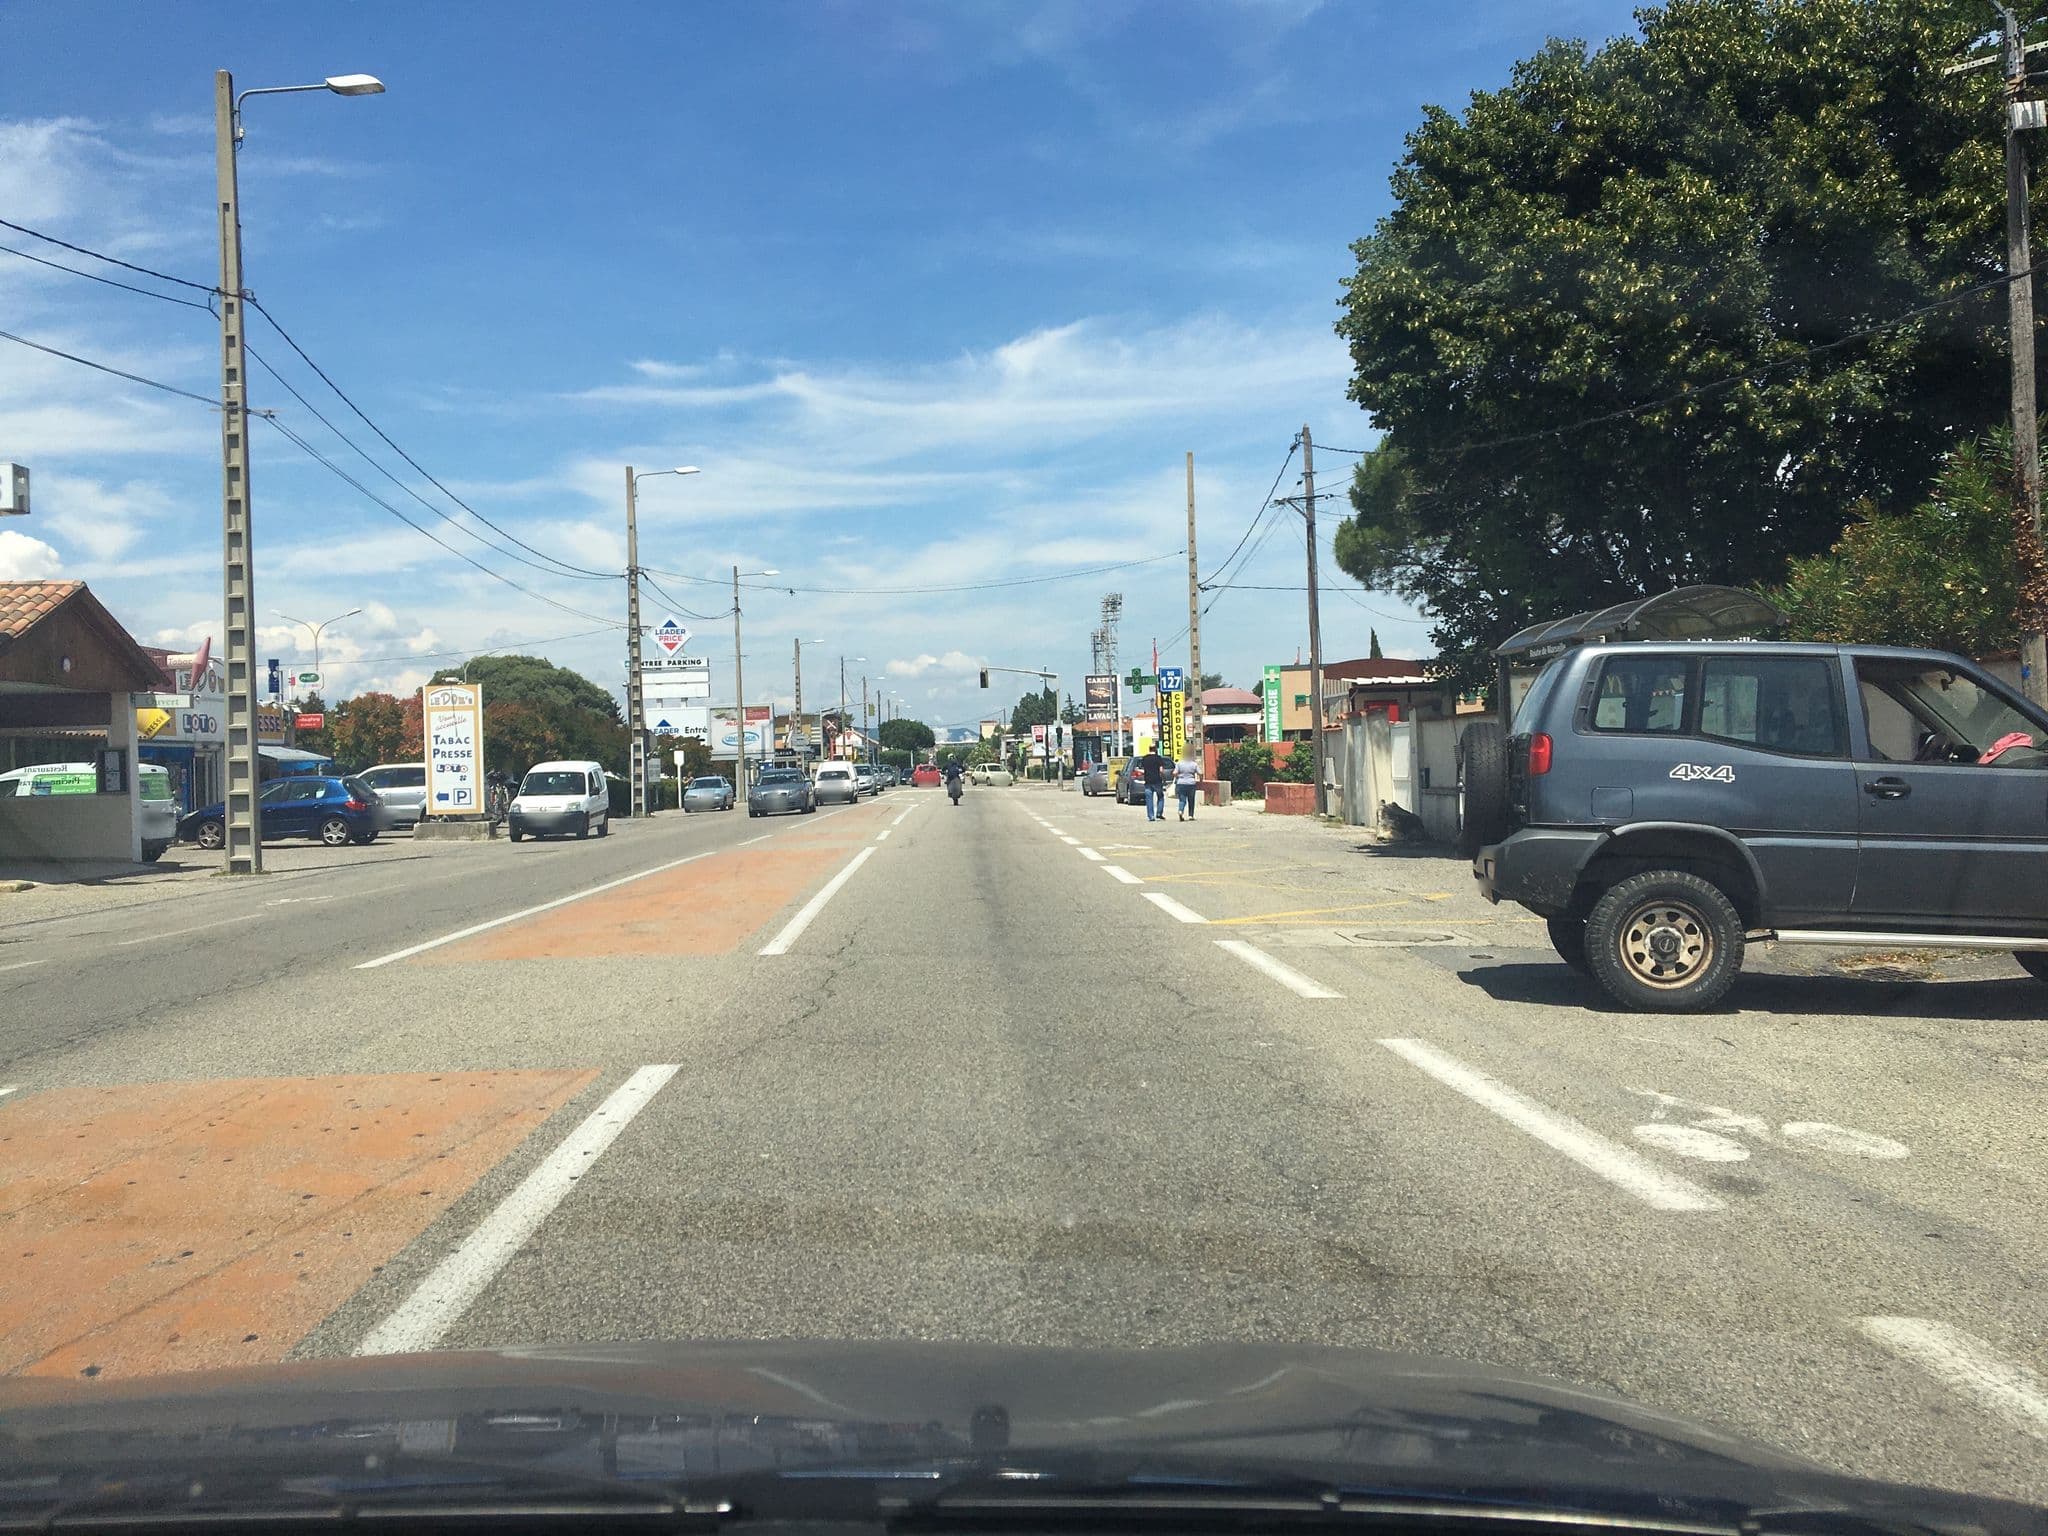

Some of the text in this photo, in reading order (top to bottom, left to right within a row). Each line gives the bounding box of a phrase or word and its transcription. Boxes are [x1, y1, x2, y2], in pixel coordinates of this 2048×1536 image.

[1160, 676, 1181, 689] 127
[1267, 688, 1280, 742] HARMACIE
[183, 713, 217, 734] LOTO
[257, 714, 281, 732] ESSE
[1162, 694, 1171, 756] VAPODROM
[433, 735, 470, 745] TABAC
[433, 748, 473, 759] PRESSE
[436, 764, 469, 773] LOTO
[1669, 763, 1736, 783] 4x4
[457, 790, 467, 803] P
